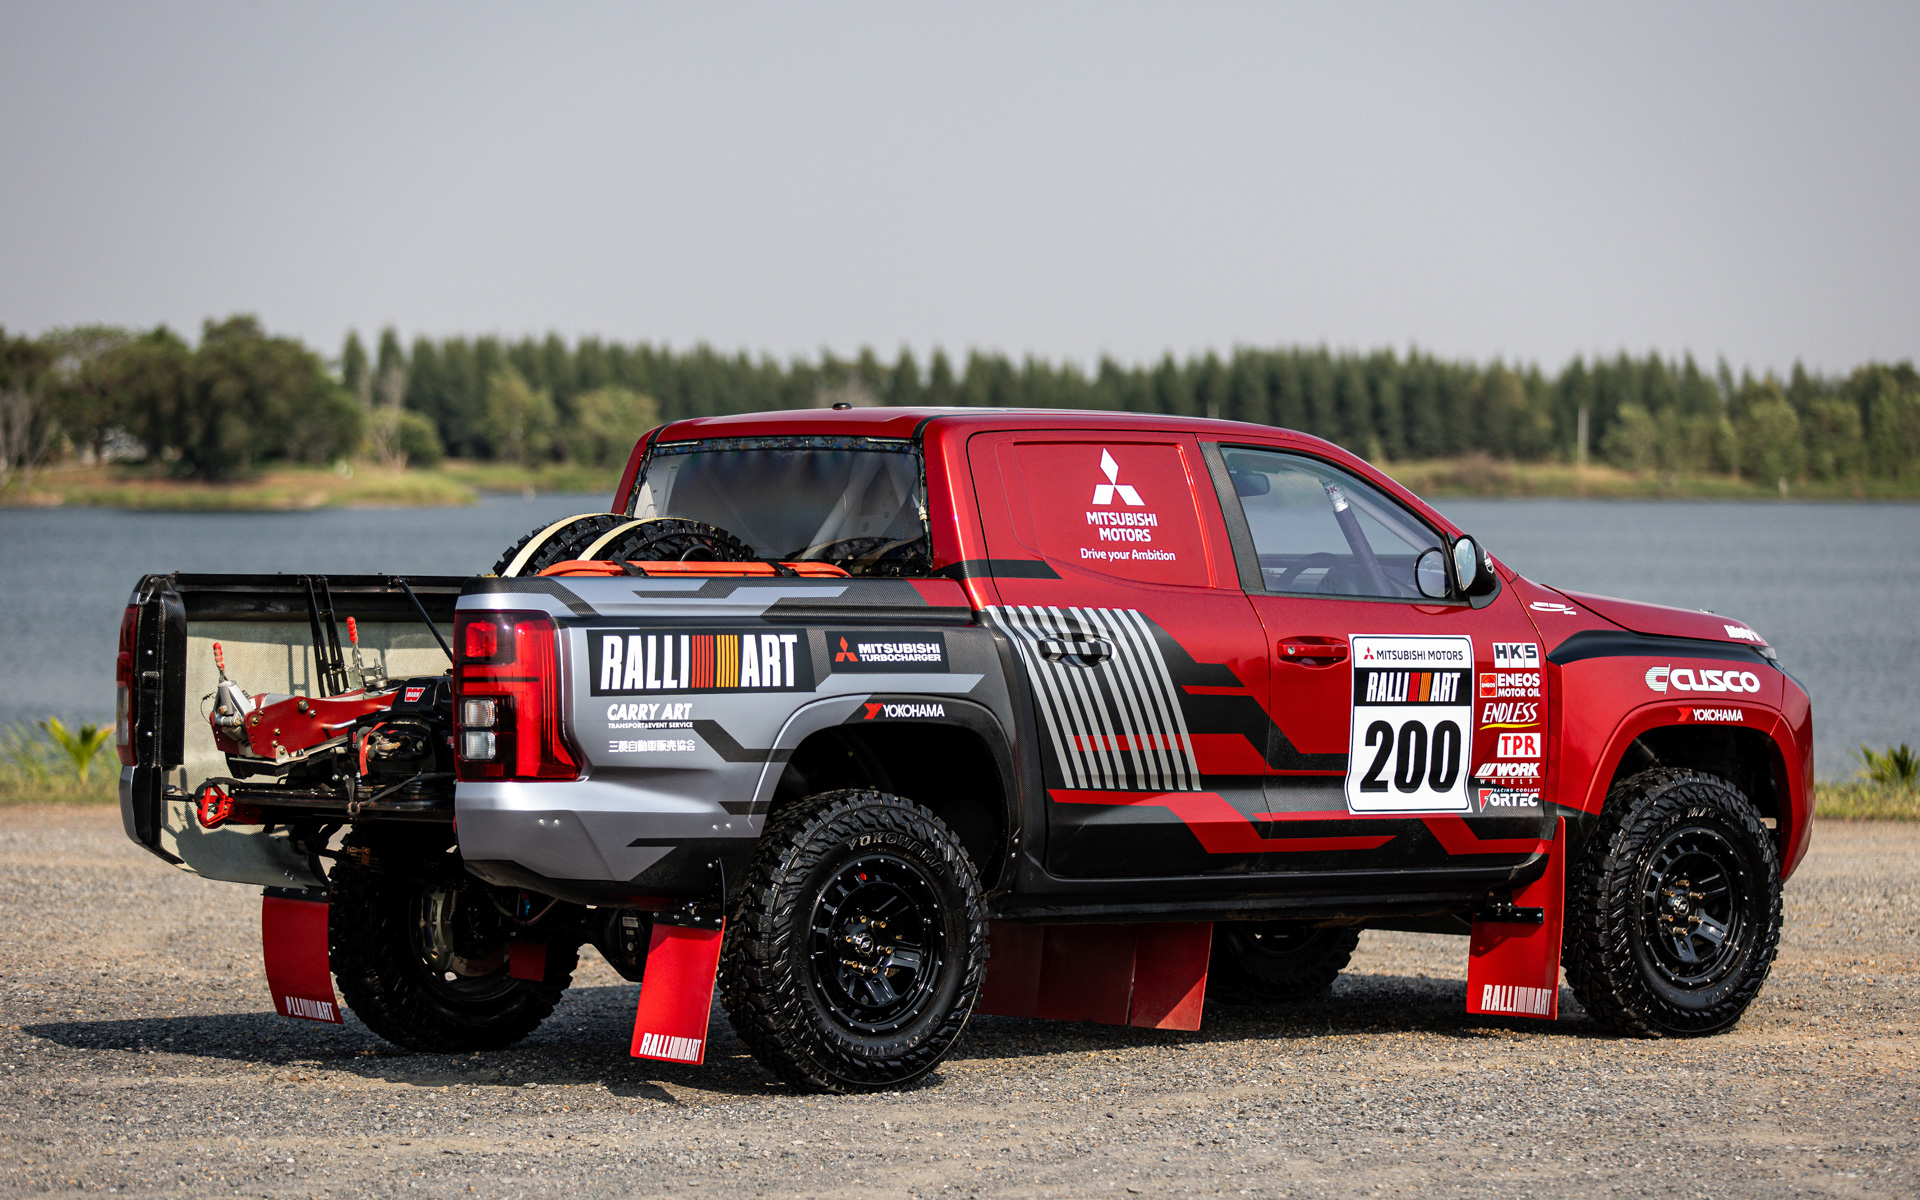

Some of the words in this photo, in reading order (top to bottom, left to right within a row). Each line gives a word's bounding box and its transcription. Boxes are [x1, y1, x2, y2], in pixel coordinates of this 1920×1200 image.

[1086, 511, 1158, 526] MITSUBISHI
[1099, 527, 1152, 542] MOTORS
[1080, 547, 1107, 559] Drive
[1108, 550, 1130, 562] your
[1131, 549, 1176, 560] Ambition
[858, 643, 940, 654] MITSUBISHI
[1376, 650, 1426, 660] MITSUBISHI
[1427, 650, 1464, 660] MOTORS
[1494, 644, 1537, 659] HKS
[859, 654, 941, 662] TURBOCHARGER
[1497, 672, 1541, 687] ENEOS
[1670, 668, 1760, 693] CUSCO
[1498, 688, 1526, 697] MOTOR
[1527, 688, 1541, 697] OIL
[607, 703, 661, 721] CARRY
[661, 703, 693, 720] ART
[883, 704, 945, 718] YOKOHAMA
[1481, 702, 1539, 723] ENDLESS
[1692, 709, 1743, 721] YOKOHAMA
[608, 739, 696, 753] 三菱自動車販売協会
[1501, 735, 1537, 756] TPR
[1360, 720, 1461, 794] 200
[845, 831, 946, 877] YOKOHAMA
